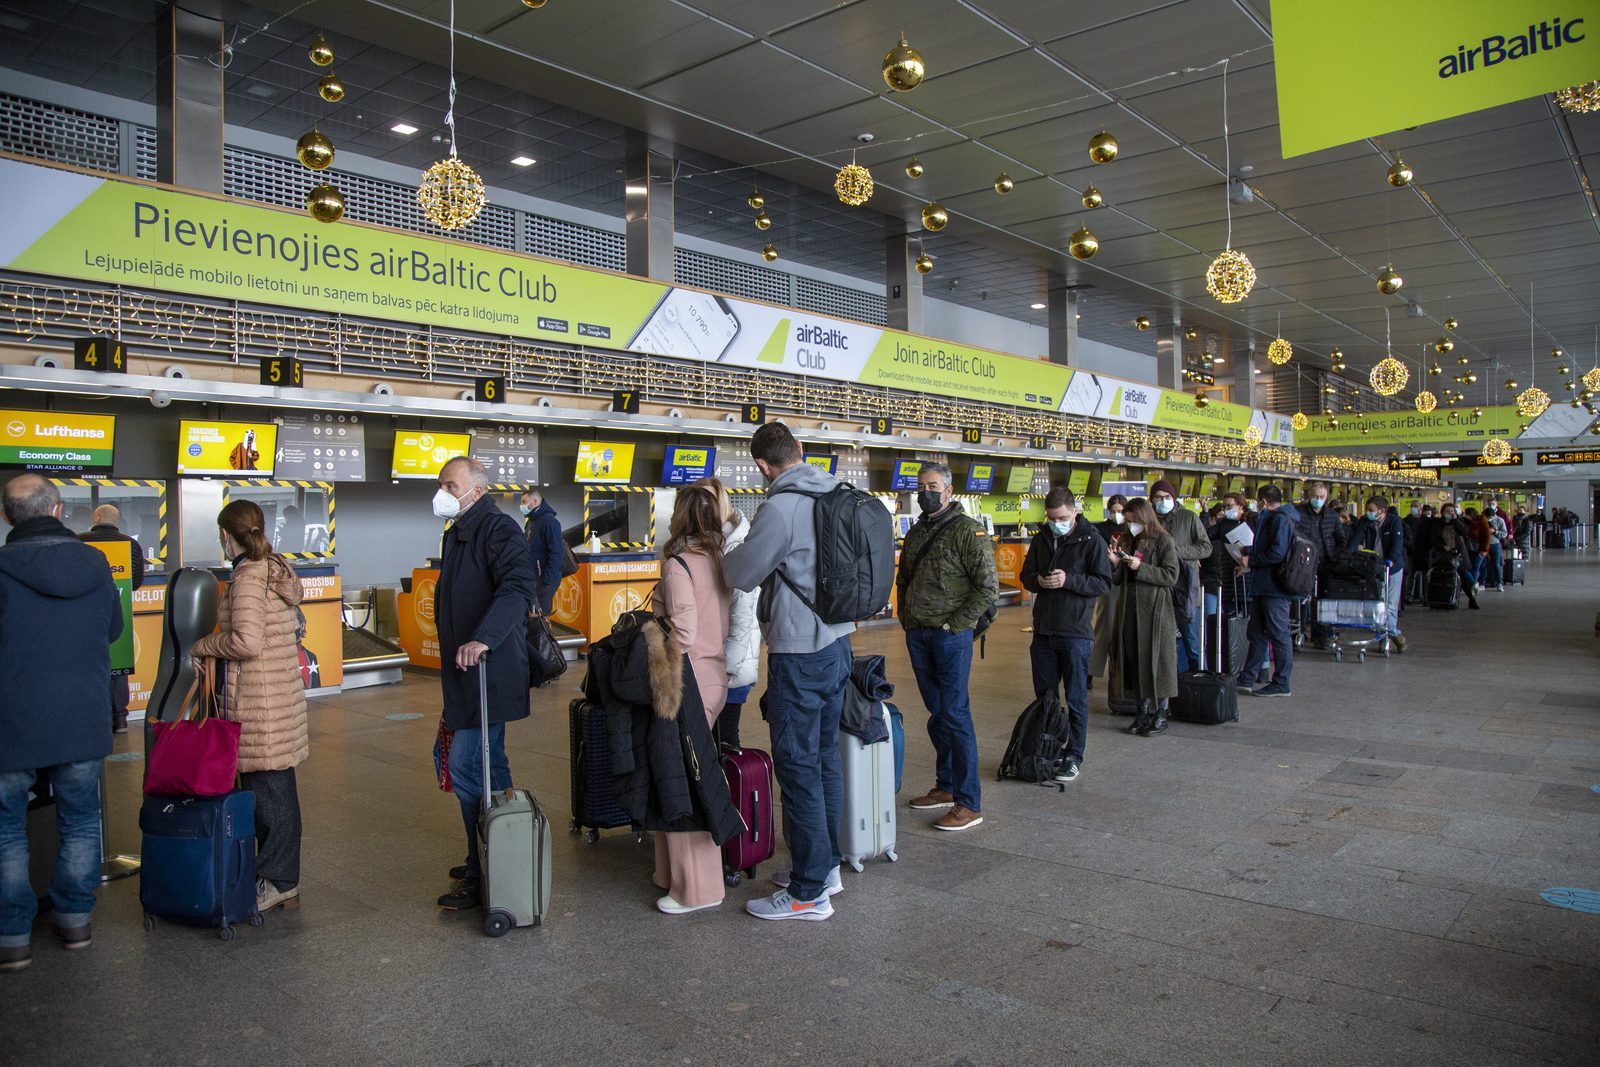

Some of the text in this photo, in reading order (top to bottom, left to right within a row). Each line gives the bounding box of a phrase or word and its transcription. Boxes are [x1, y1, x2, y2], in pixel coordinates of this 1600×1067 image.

[1438, 17, 1586, 79] airBaltic
[134, 201, 557, 303] Pievienojies airBaltic Club
[85, 249, 520, 325] Lejupielādē mobilo lietotni un saņem balvas pēc katra lidojuma
[688, 304, 697, 317] 10
[796, 324, 849, 350] airBaltic
[85, 342, 98, 367] 4
[113, 345, 122, 369] 4
[796, 347, 826, 371] Club
[893, 341, 996, 379] Join airBaltic Club
[270, 360, 281, 382] 5
[294, 362, 300, 384] 5
[878, 368, 905, 381] Download
[905, 373, 915, 383] the
[915, 375, 933, 387] mobile
[933, 378, 943, 389] app
[943, 378, 952, 388] and
[484, 380, 496, 399] 6
[1124, 389, 1148, 405] airBaltic
[621, 393, 632, 410] 7
[749, 405, 759, 421] 8
[1124, 404, 1138, 419] Club
[877, 419, 886, 433] 9
[1390, 415, 1444, 429] airBaltic
[1447, 413, 1478, 426] Club
[35, 424, 105, 439] Lufthansa
[964, 429, 980, 442] 10
[1032, 435, 1045, 448] 11
[1068, 439, 1081, 451] 12
[19, 451, 92, 462] Economy Class
[678, 453, 702, 463] airBaltic
[1126, 446, 1139, 457] 13
[1155, 449, 1167, 460] 14
[1197, 453, 1207, 463] 15
[1230, 457, 1240, 467] 16
[1249, 459, 1258, 468] 17
[995, 500, 1019, 512] airBaltic
